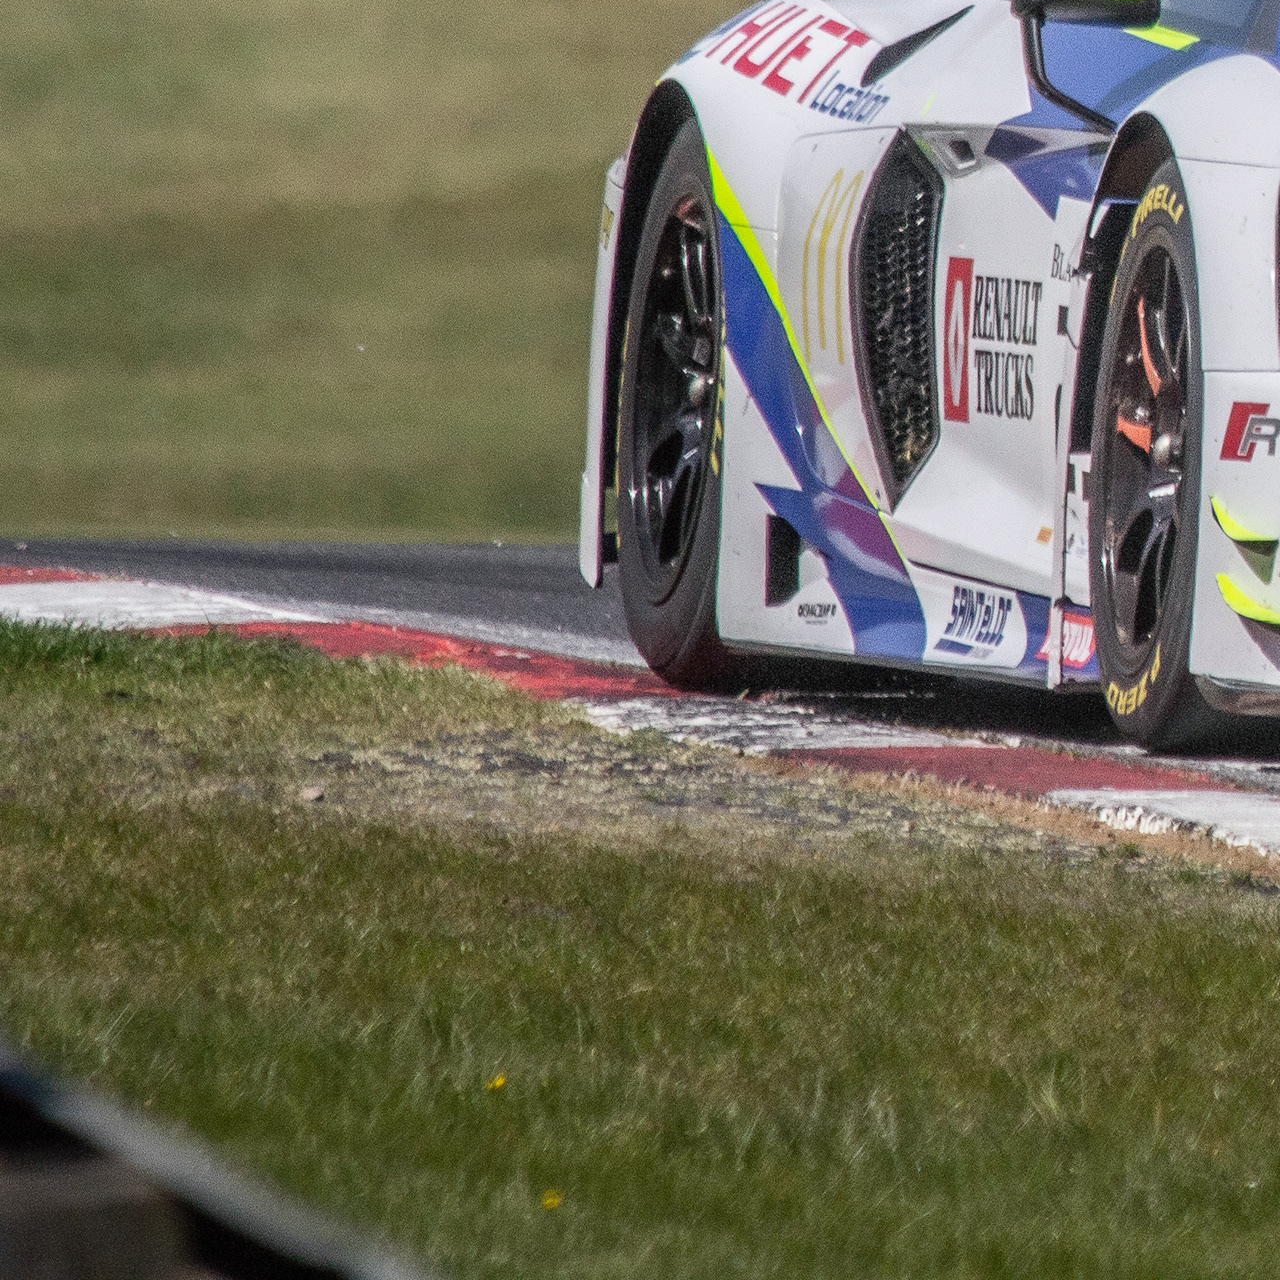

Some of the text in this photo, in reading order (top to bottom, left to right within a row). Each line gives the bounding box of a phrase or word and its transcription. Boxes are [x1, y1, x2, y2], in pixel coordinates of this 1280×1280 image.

[705, 0, 873, 104] HUET
[972, 275, 1042, 346] RENAULT
[974, 349, 1034, 421] TRUCKS
